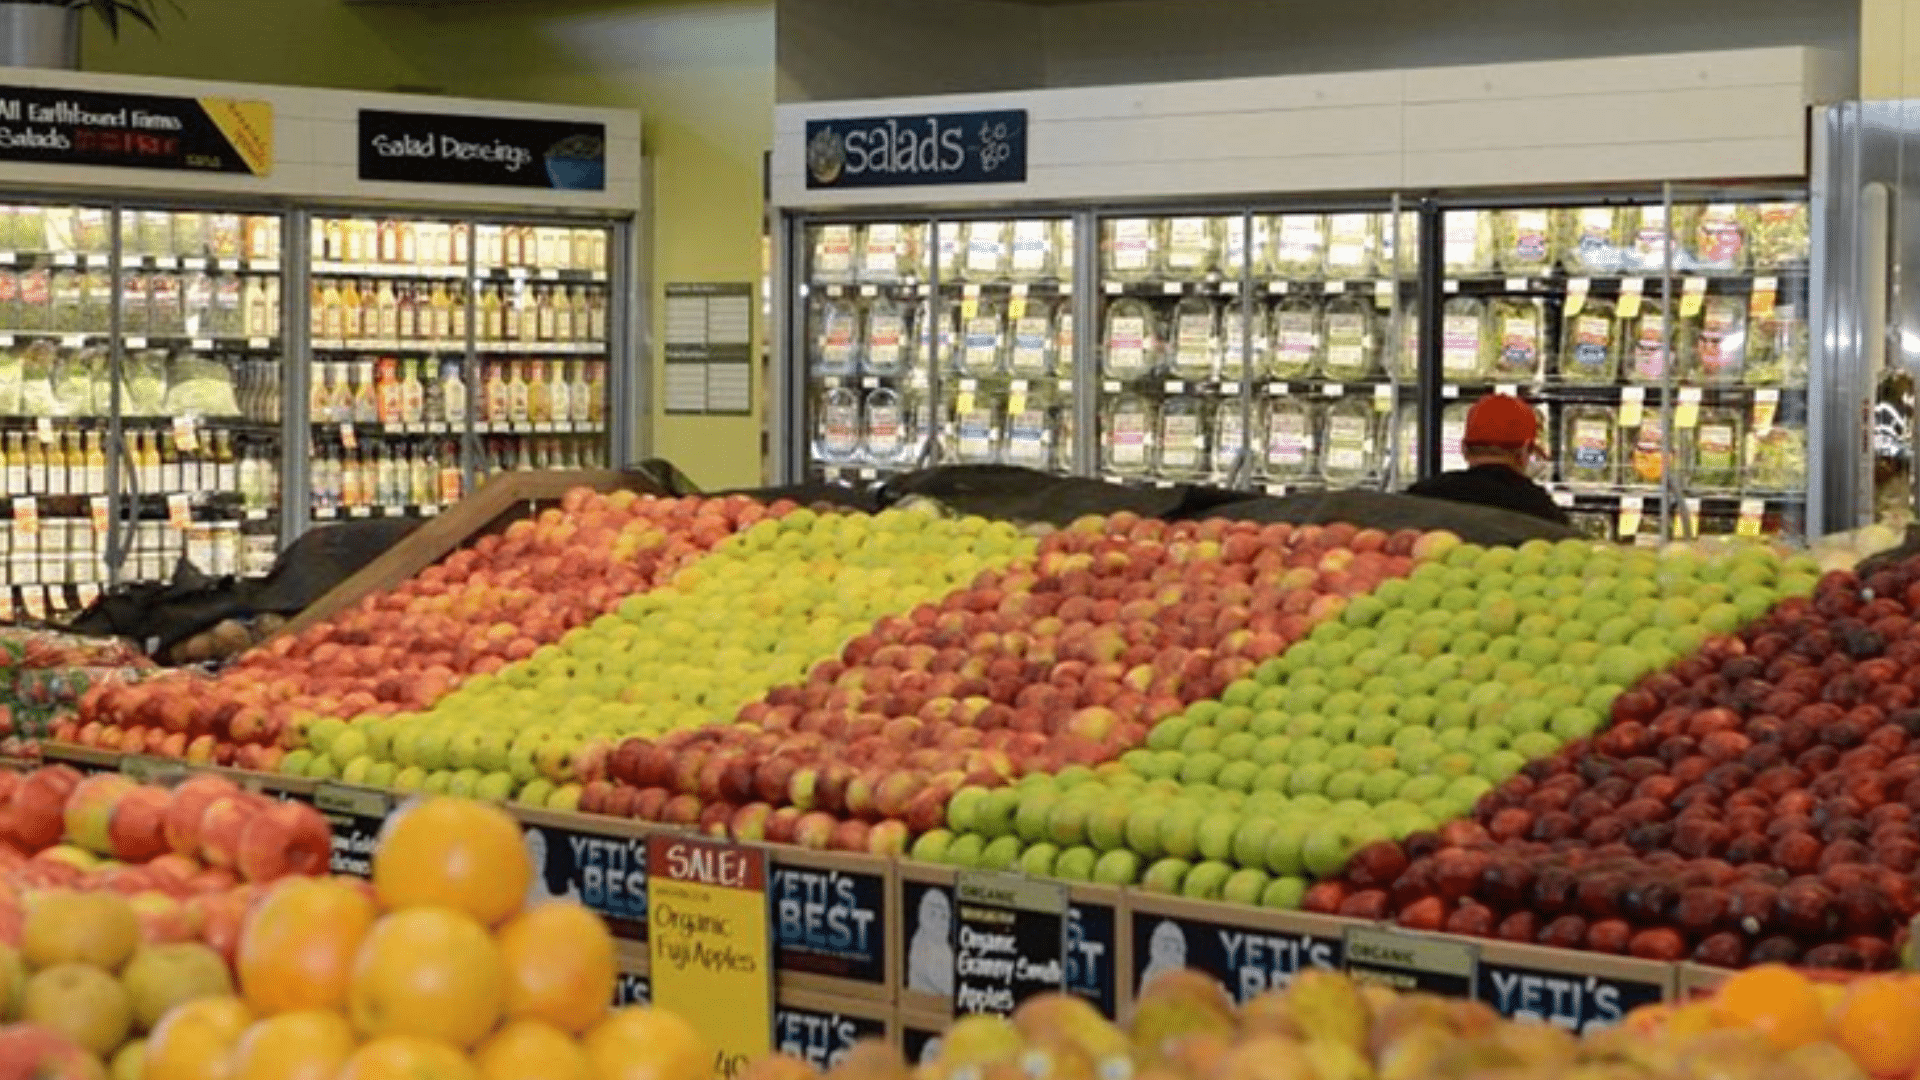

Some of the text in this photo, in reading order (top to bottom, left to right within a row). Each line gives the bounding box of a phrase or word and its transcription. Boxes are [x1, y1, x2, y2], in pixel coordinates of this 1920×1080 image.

[28, 102, 127, 128] Earthbound
[131, 109, 183, 131] Farms
[0, 126, 71, 149] Salads
[371, 132, 436, 157] Salad
[845, 117, 965, 174] salads
[667, 844, 747, 887] SALE!
[583, 865, 647, 908] BES
[655, 903, 732, 938] Organic
[779, 899, 876, 949] BEST
[959, 923, 1018, 957] Organic
[692, 941, 757, 973] Apples
[1218, 930, 1334, 974] YETI'S
[1490, 970, 1622, 1022] YETI'S
